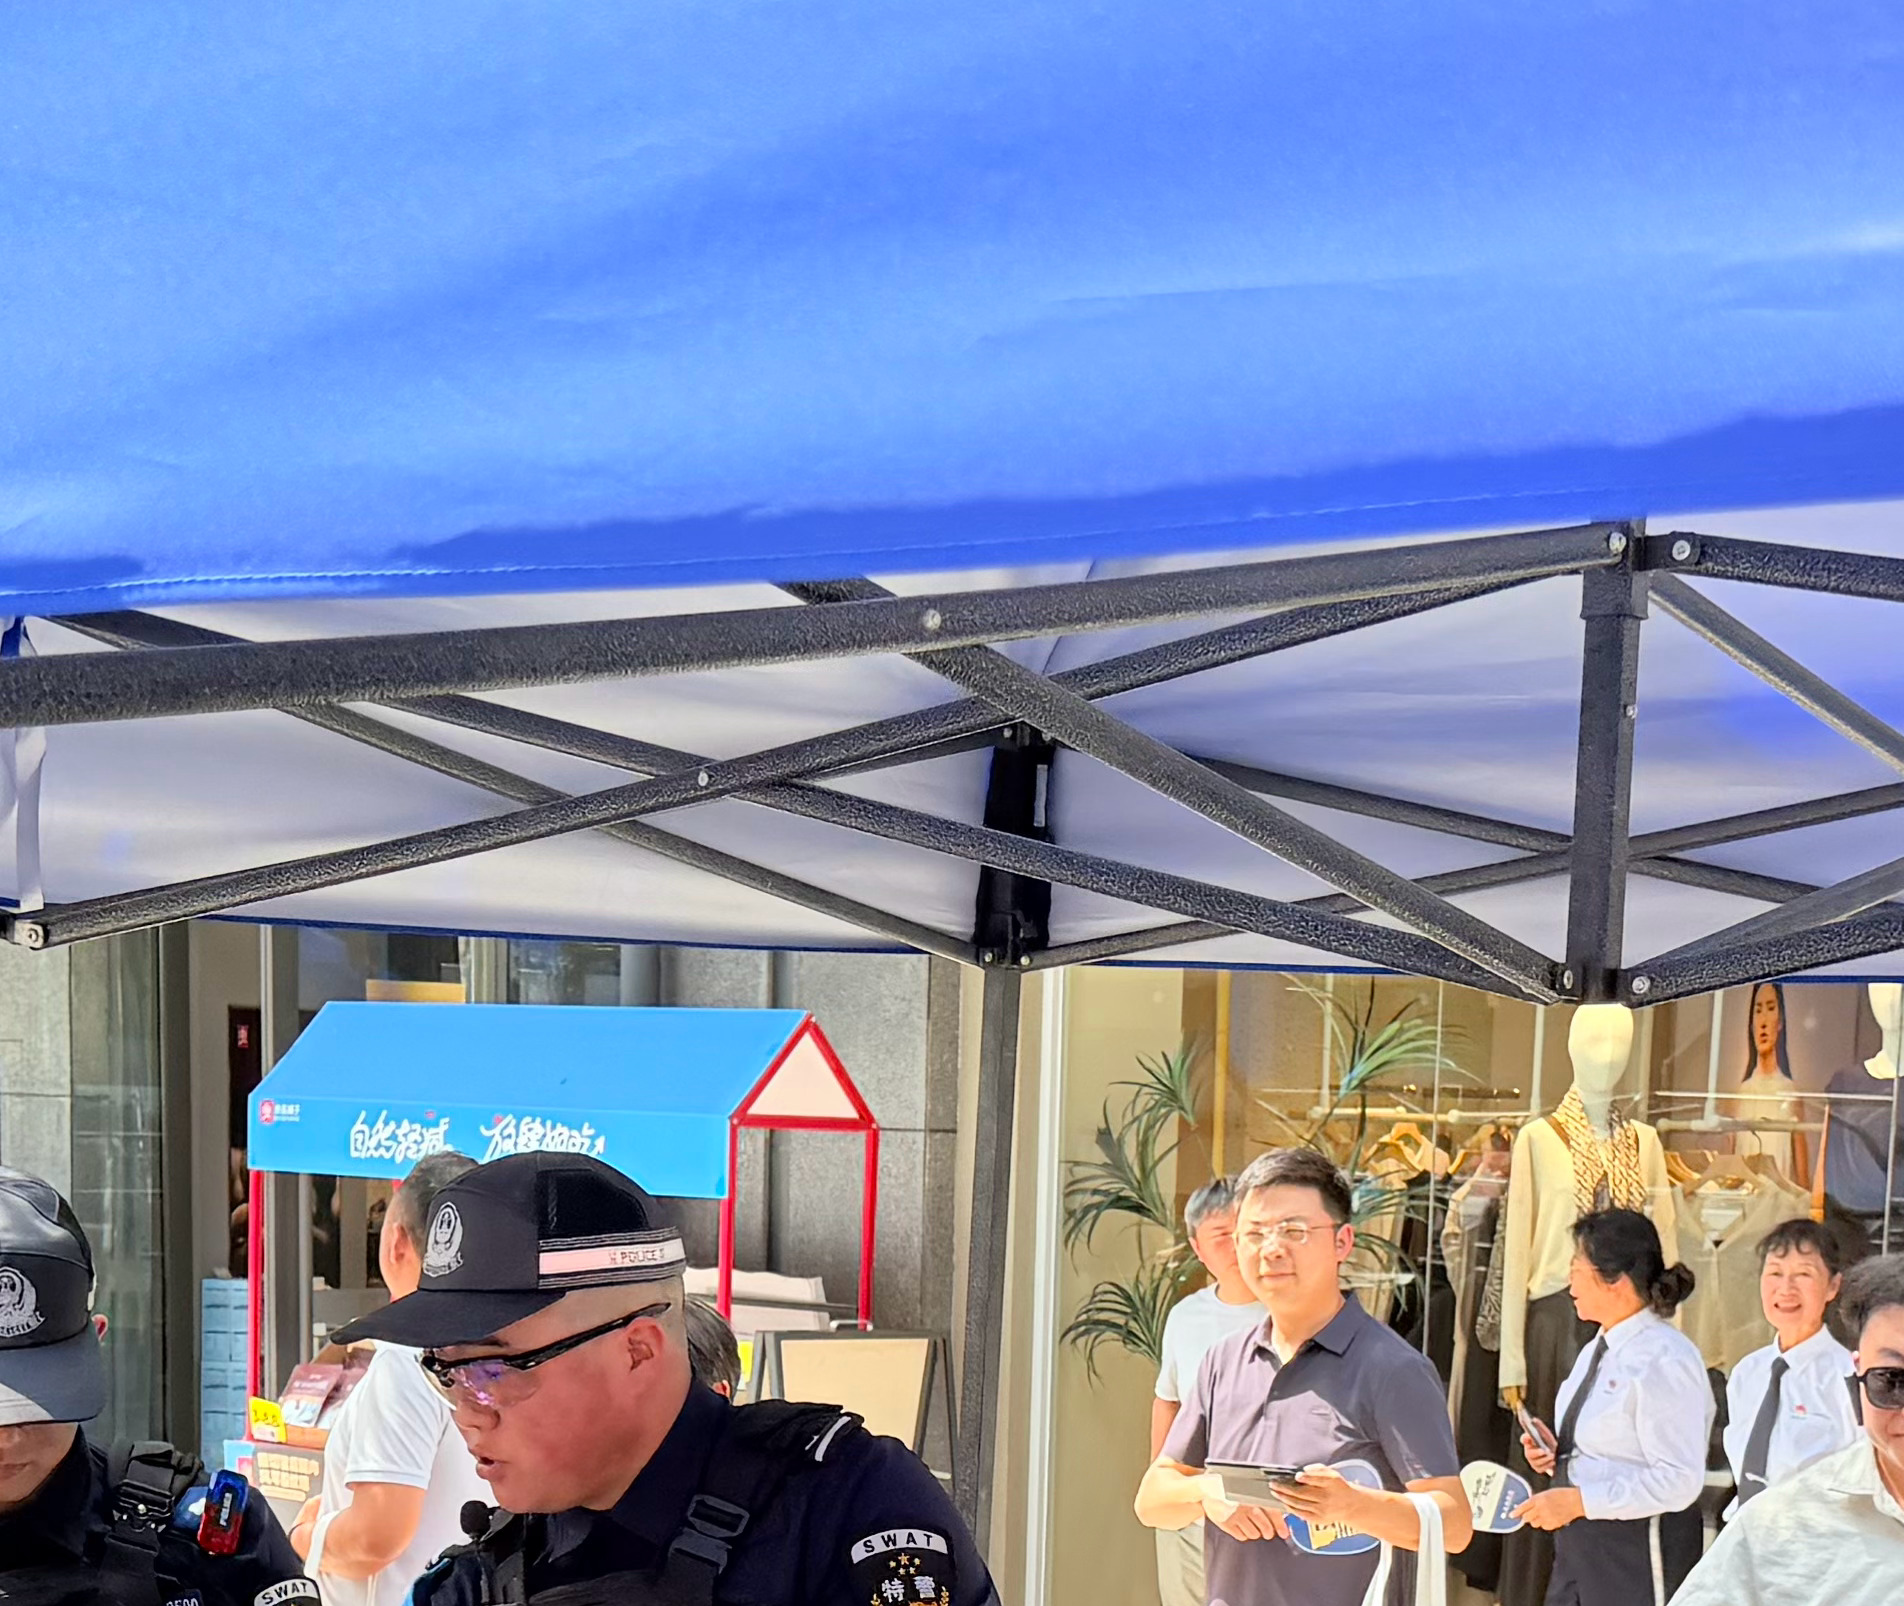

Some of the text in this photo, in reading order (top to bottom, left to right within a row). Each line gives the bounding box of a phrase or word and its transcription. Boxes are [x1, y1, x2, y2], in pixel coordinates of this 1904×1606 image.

[621, 1249, 659, 1263] POLICE
[861, 1531, 934, 1554] SWAT
[261, 1581, 308, 1605] SWAT
[881, 1575, 936, 1603] 特警
